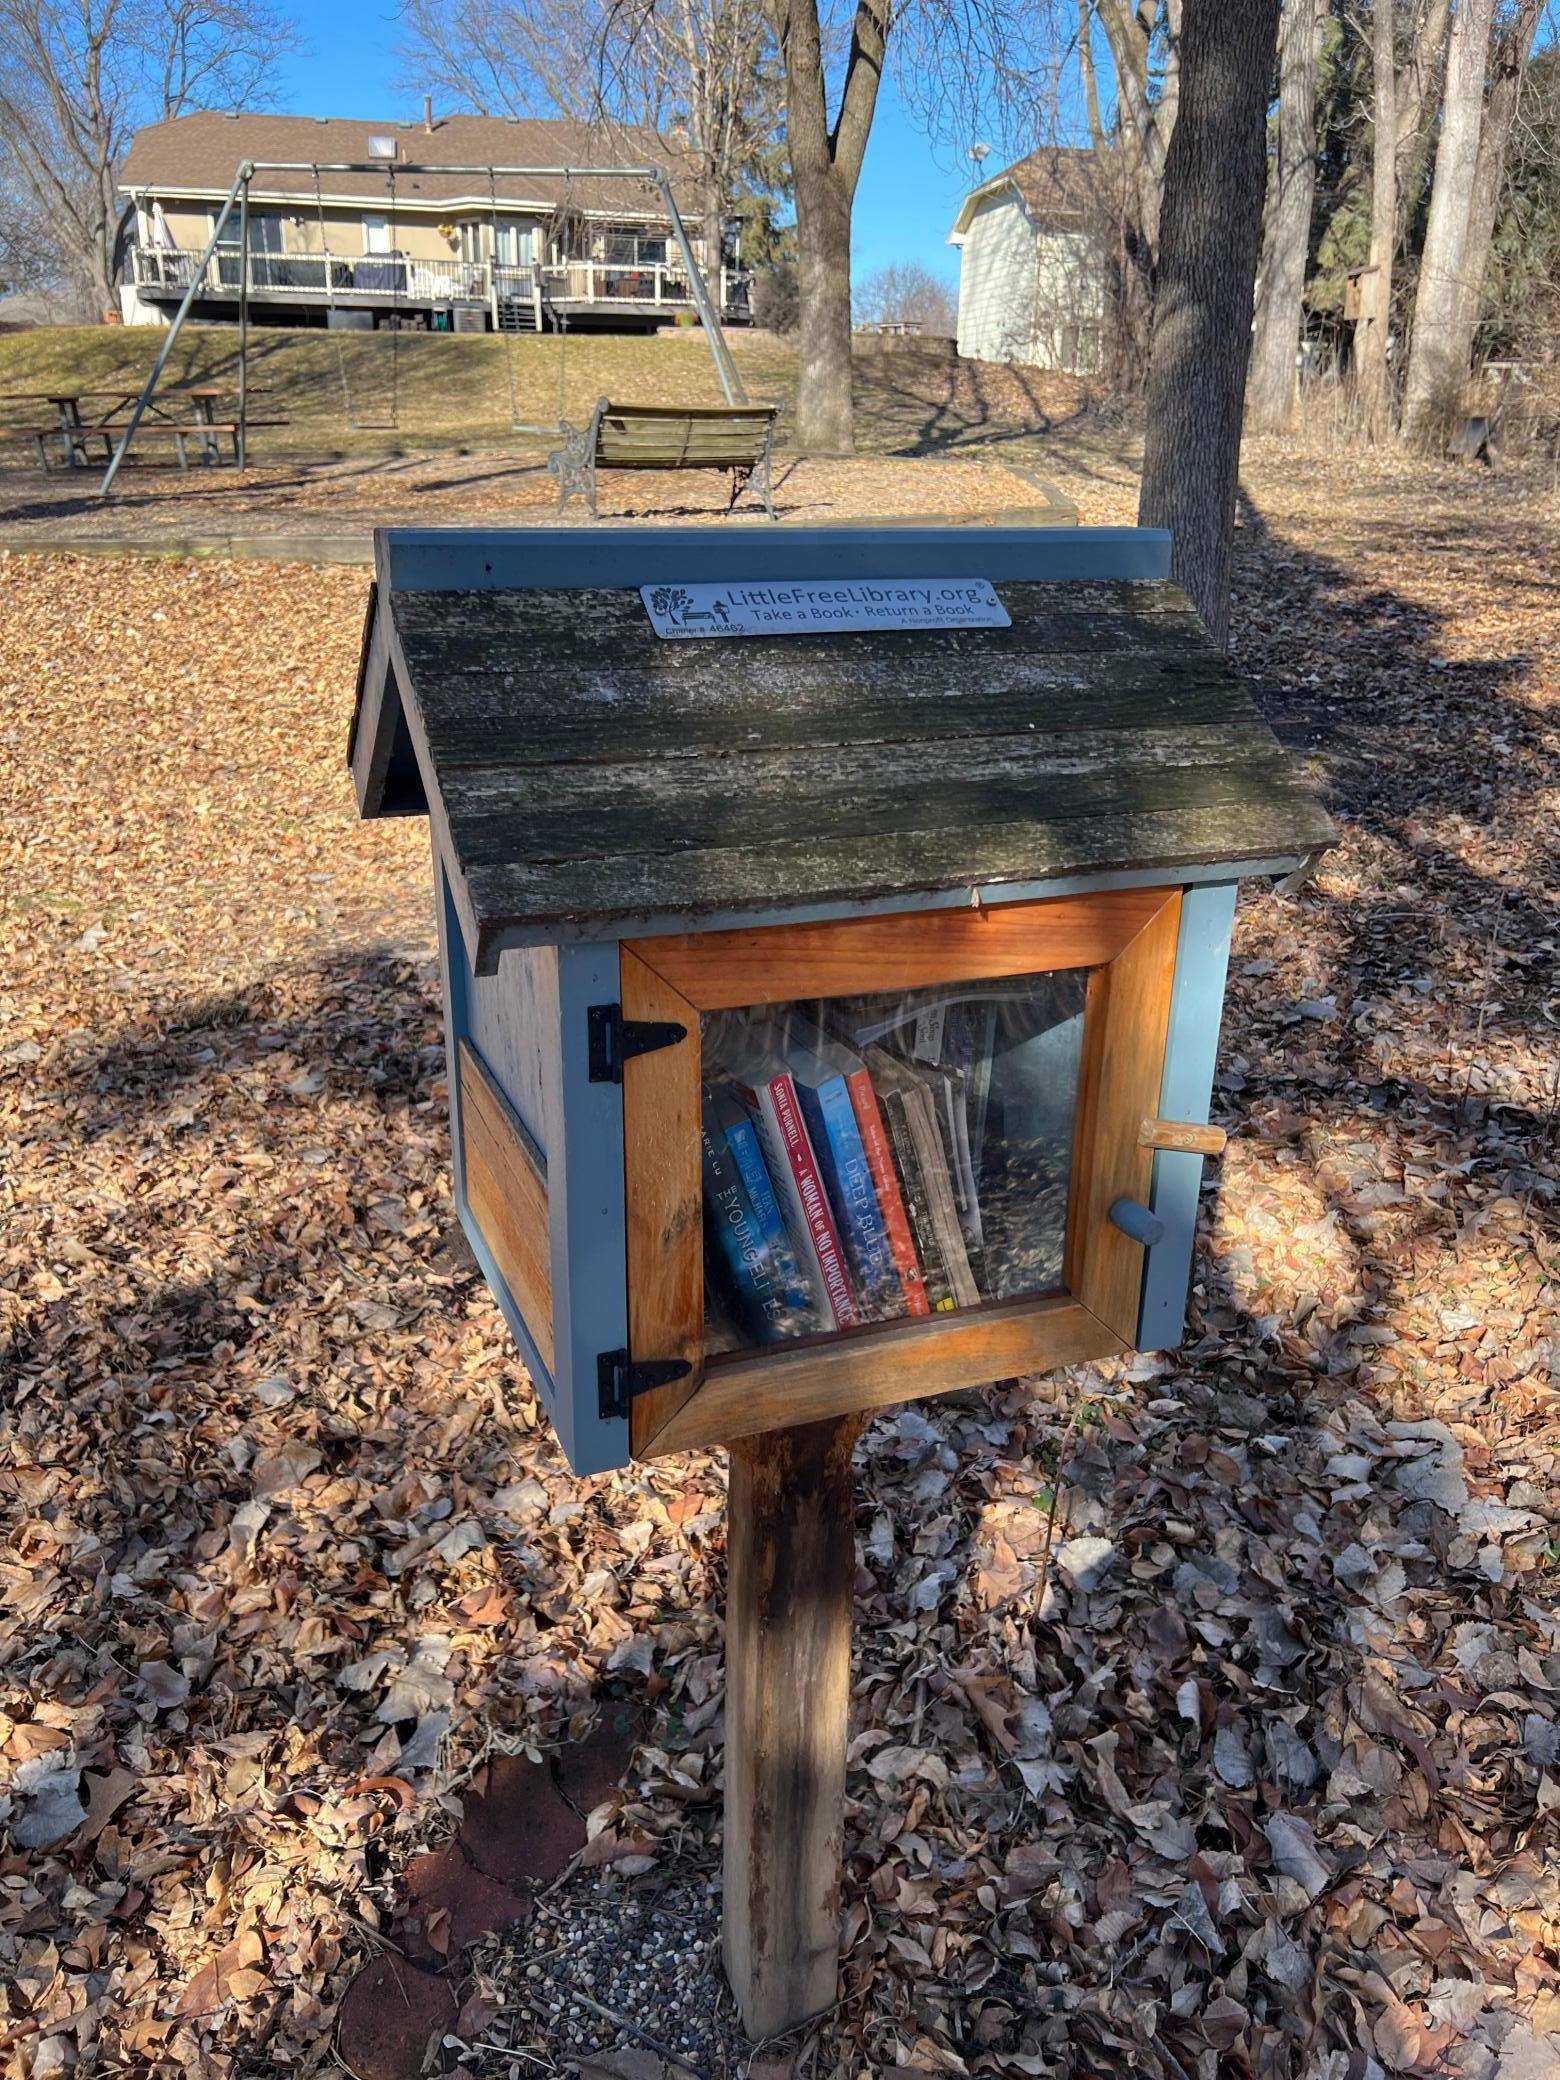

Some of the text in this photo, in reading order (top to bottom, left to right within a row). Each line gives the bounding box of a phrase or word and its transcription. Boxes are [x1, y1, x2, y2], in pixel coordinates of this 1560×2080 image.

[727, 588, 982, 606] LittleFreeLibrary.org
[751, 603, 975, 622] Take a Book Return a Book
[773, 1082, 800, 1148] SONIA PURNELL
[716, 1184, 738, 1201] THE
[845, 1158, 869, 1210] DEEP
[724, 1196, 759, 1264] YOUNG
[749, 1261, 789, 1322] ELIES
[799, 1168, 854, 1325] A WOMAN OF NO IMPORTANCE
